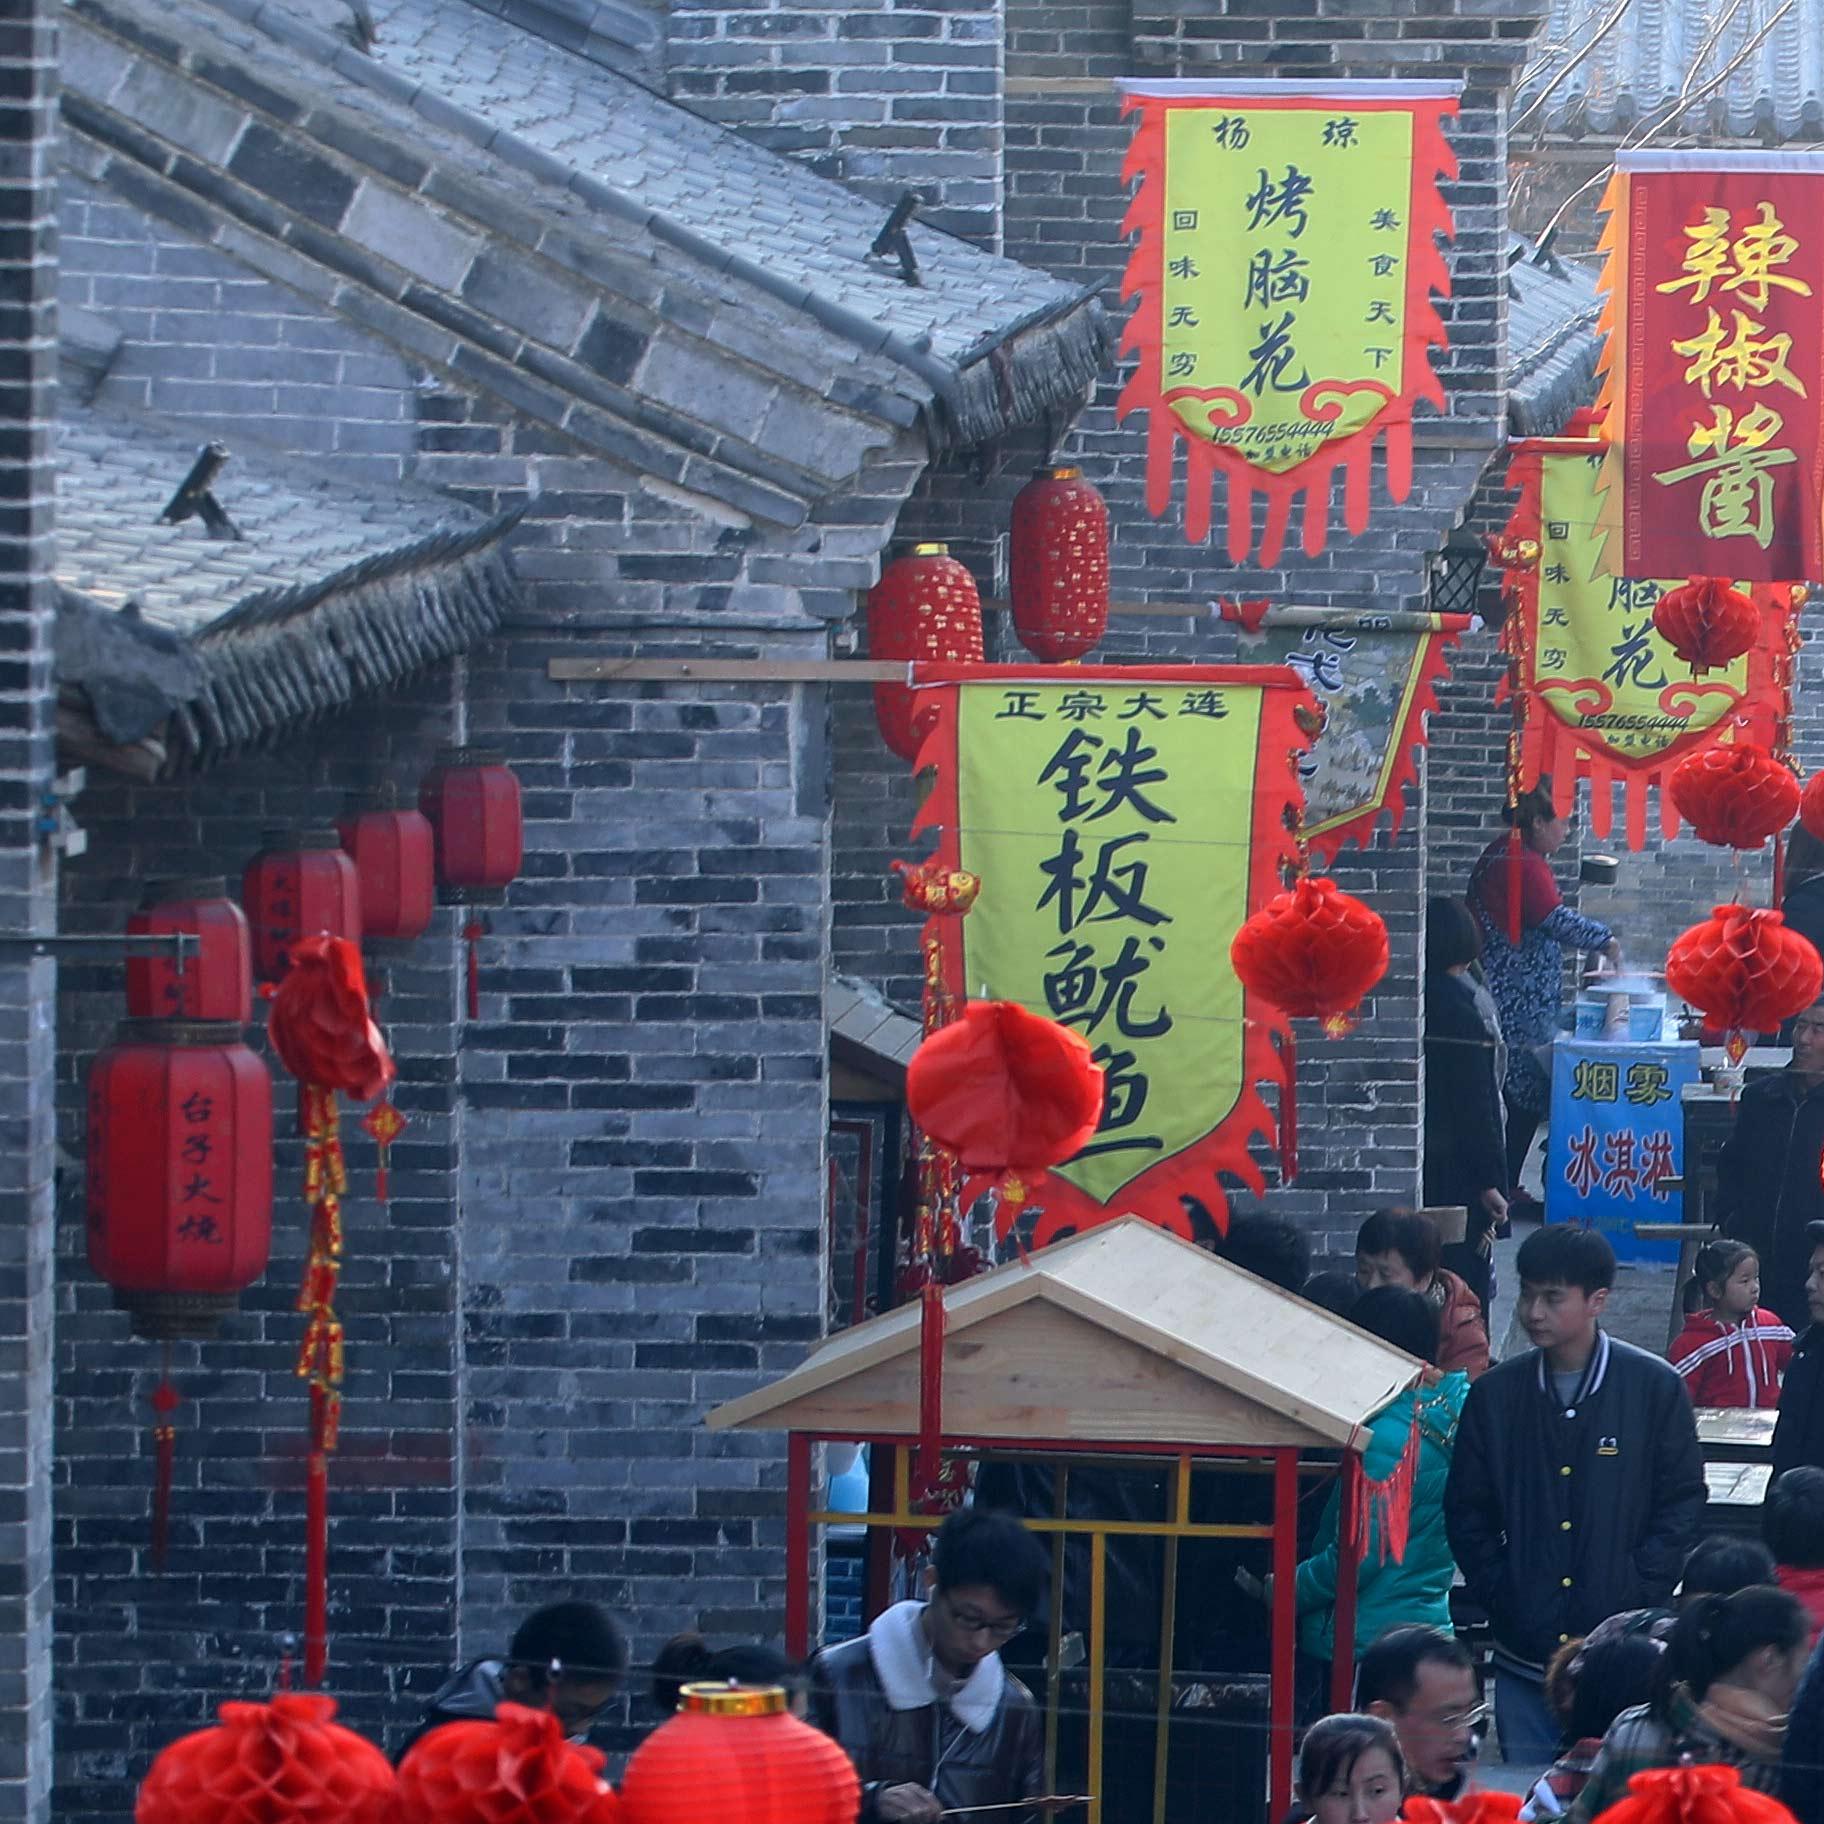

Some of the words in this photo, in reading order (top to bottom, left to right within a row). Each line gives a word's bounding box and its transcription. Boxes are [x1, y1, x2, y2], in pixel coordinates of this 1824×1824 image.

[1167, 209, 1200, 379] 回味无穷
[1241, 164, 1312, 394] 烤脑花
[1364, 207, 1401, 371] 美食天下
[1655, 199, 1813, 551] 辣椒酱
[1541, 521, 1571, 672] 回味无穷
[996, 690, 1230, 721] 正宗大连
[1578, 713, 1690, 732] 15576554444
[1565, 1123, 1676, 1202] 冰淇淋
